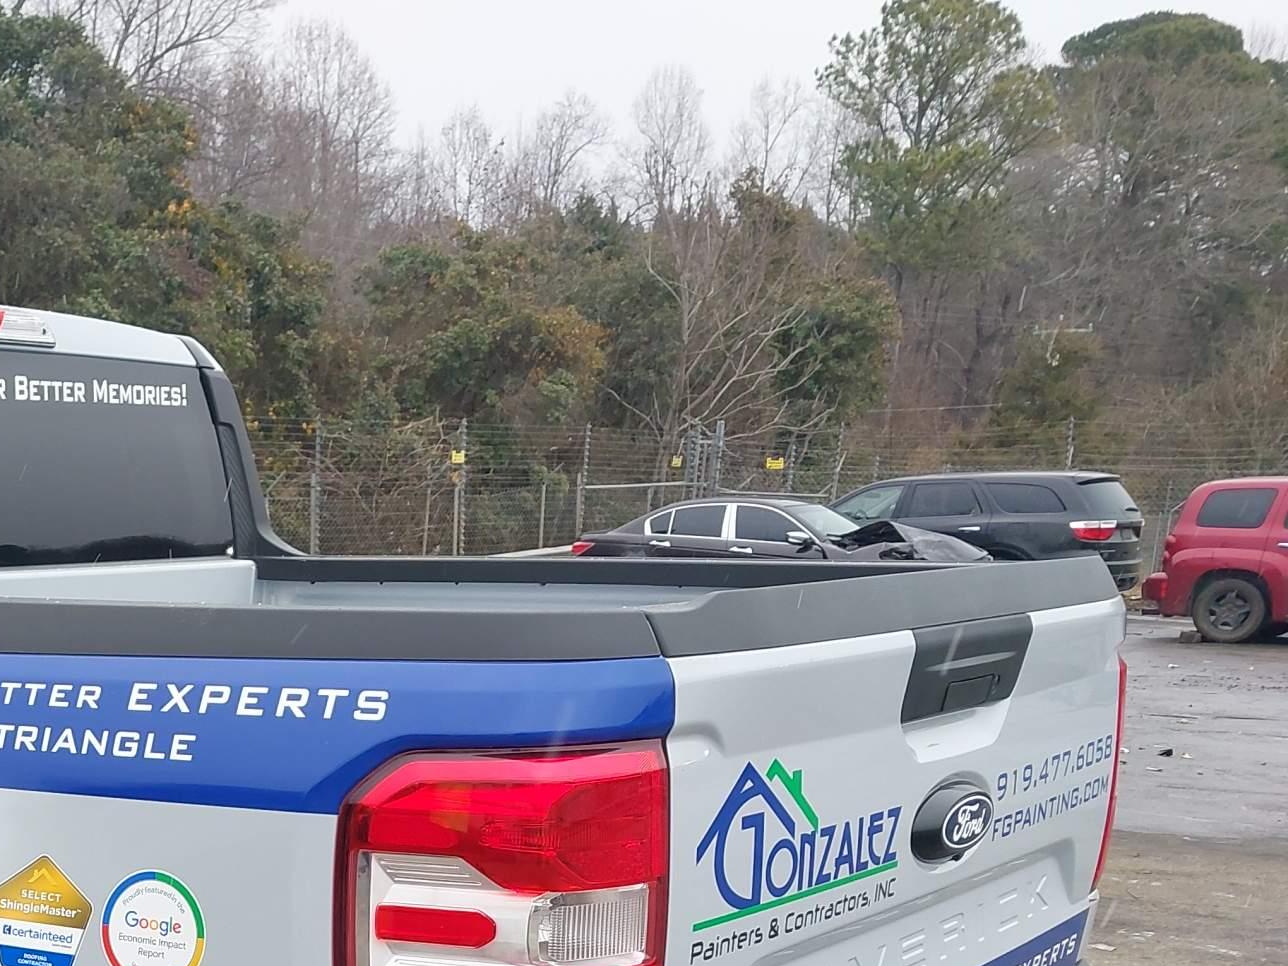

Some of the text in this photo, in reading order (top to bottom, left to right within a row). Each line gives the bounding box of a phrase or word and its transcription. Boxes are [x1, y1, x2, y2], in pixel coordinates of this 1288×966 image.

[15, 375, 86, 403] BETTER
[93, 380, 187, 407] MEMORIES!
[127, 682, 390, 721] EXPERTS
[997, 734, 1113, 801] 919.477.6058
[953, 803, 987, 842] Ford
[991, 775, 1109, 842] FGPAINTING.COM
[21, 889, 62, 902] SELECT
[12, 927, 73, 944] certainteed
[124, 910, 182, 937] Google
[690, 878, 897, 965] Painters & Contractors, INC
[118, 932, 187, 951] Economic Impact
[137, 947, 165, 960] Report
